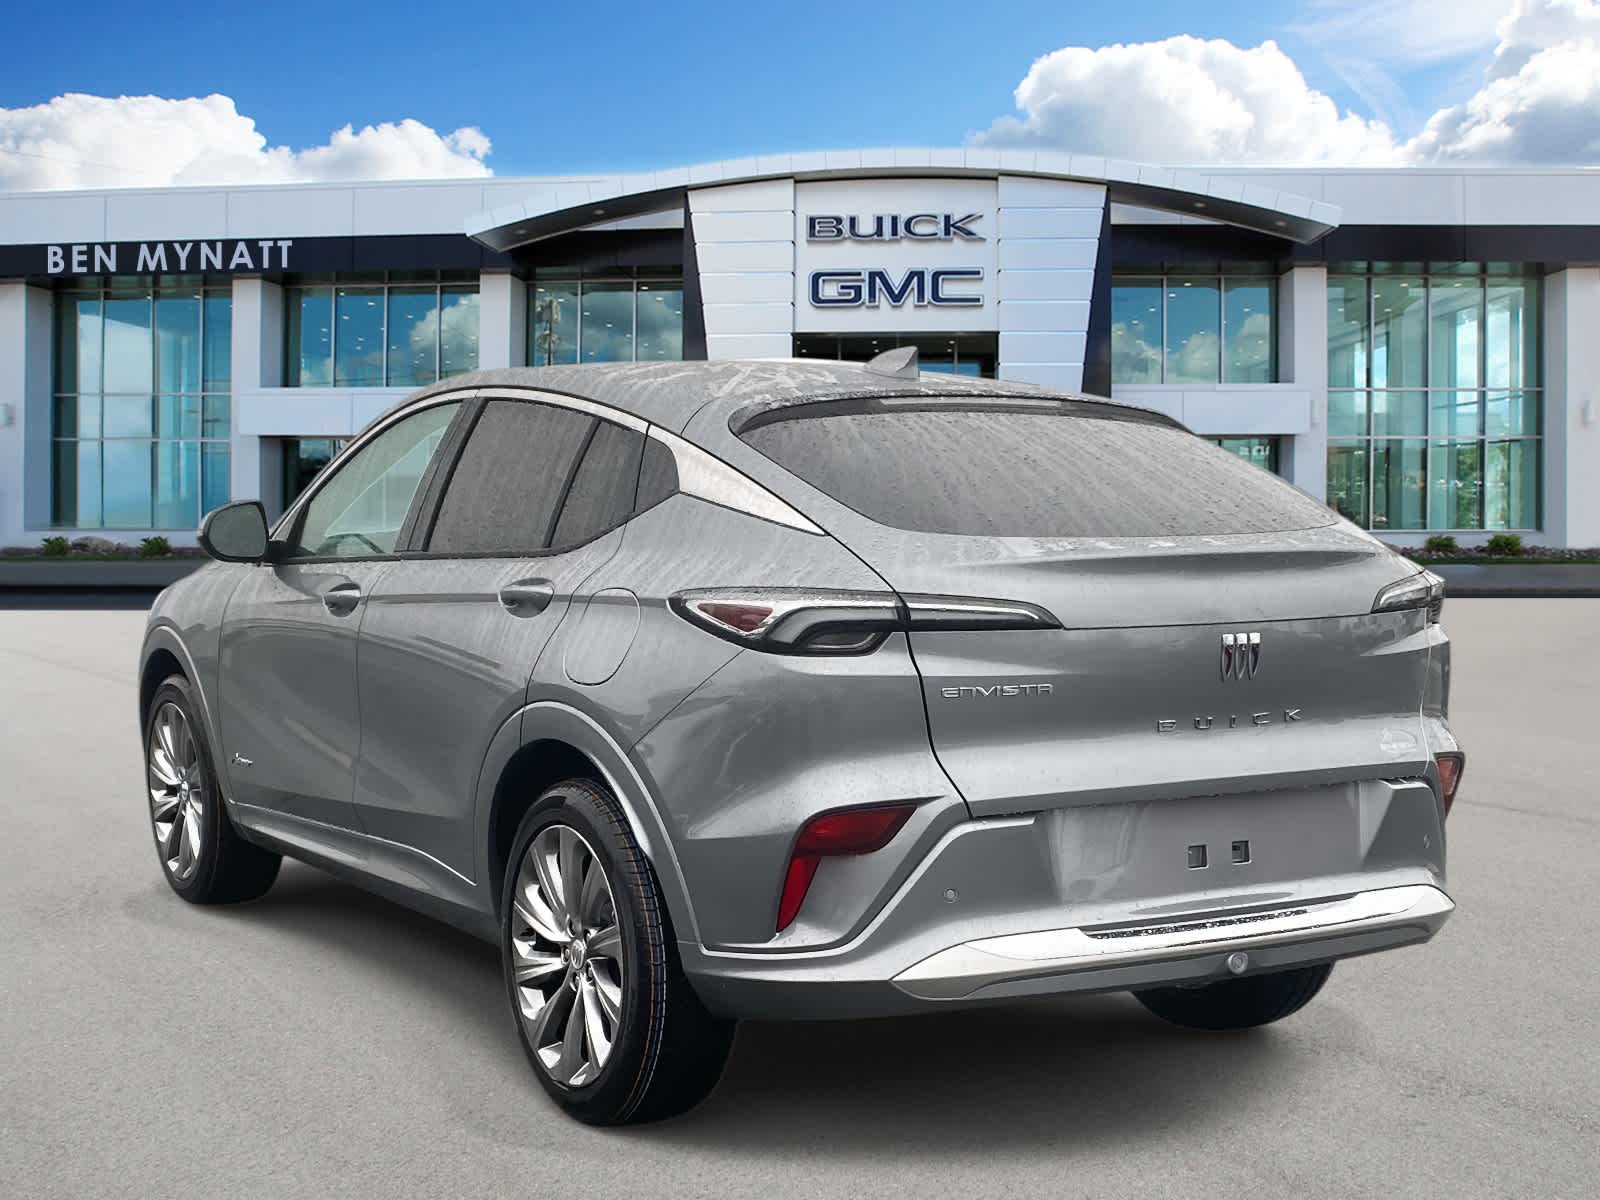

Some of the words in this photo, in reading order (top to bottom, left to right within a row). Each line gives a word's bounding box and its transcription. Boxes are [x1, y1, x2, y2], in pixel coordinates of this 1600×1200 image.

[807, 213, 986, 242] BUICK
[47, 245, 117, 274] BEN
[136, 240, 293, 272] MYNATT
[808, 268, 984, 308] GMC
[941, 683, 1054, 699] ENVISTA
[1157, 708, 1303, 733] BUICK
